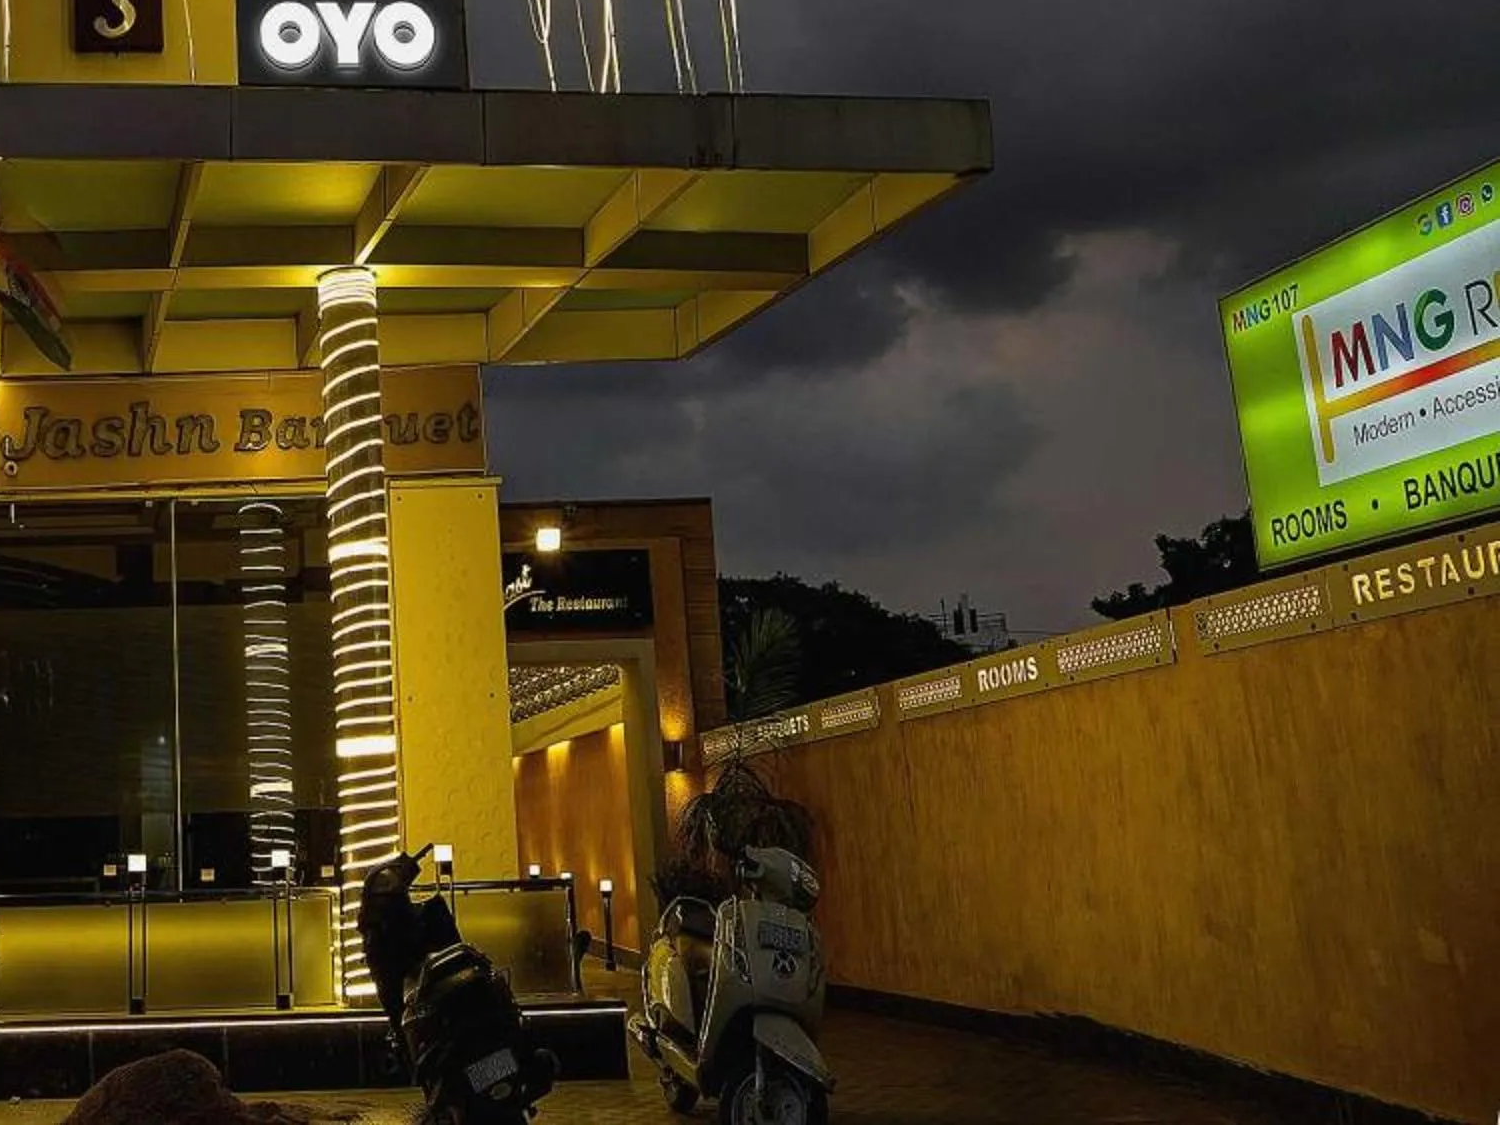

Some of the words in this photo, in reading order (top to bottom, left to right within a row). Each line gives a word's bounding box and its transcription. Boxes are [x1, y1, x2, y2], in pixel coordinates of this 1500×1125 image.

[259, 0, 436, 71] OYO
[1330, 288, 1455, 388] MNG
[1464, 269, 1500, 337] R
[7, 400, 220, 463] Jashn
[233, 402, 480, 453] Bauet
[1353, 407, 1416, 446] Modern
[1271, 500, 1348, 546] ROOMS
[530, 596, 554, 613] The
[977, 656, 1039, 693] ROOMS
